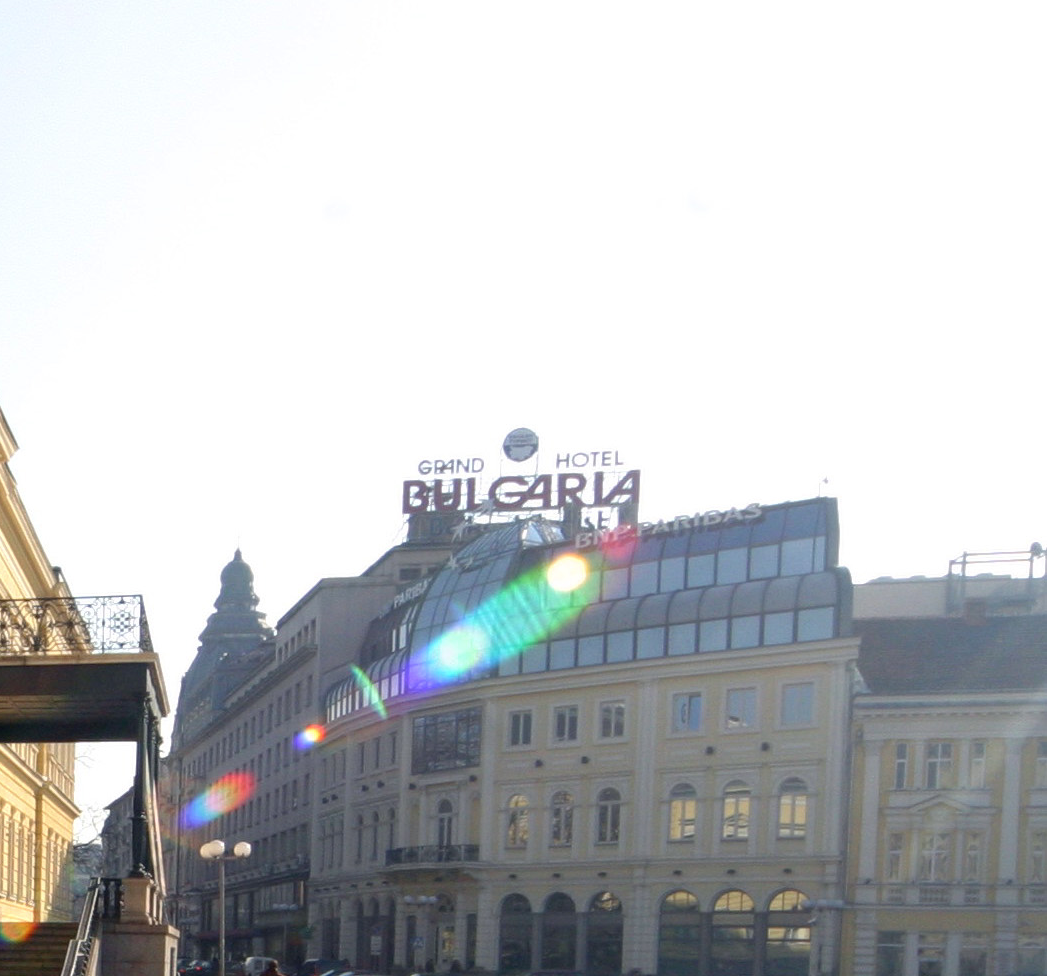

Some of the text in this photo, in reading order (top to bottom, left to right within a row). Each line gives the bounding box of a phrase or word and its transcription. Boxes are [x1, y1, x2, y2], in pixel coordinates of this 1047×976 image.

[418, 451, 624, 475] GRAND HOTEL
[402, 469, 641, 514] BULGARIA
[575, 524, 632, 549] BNP
[637, 502, 763, 537] PARIBAS
